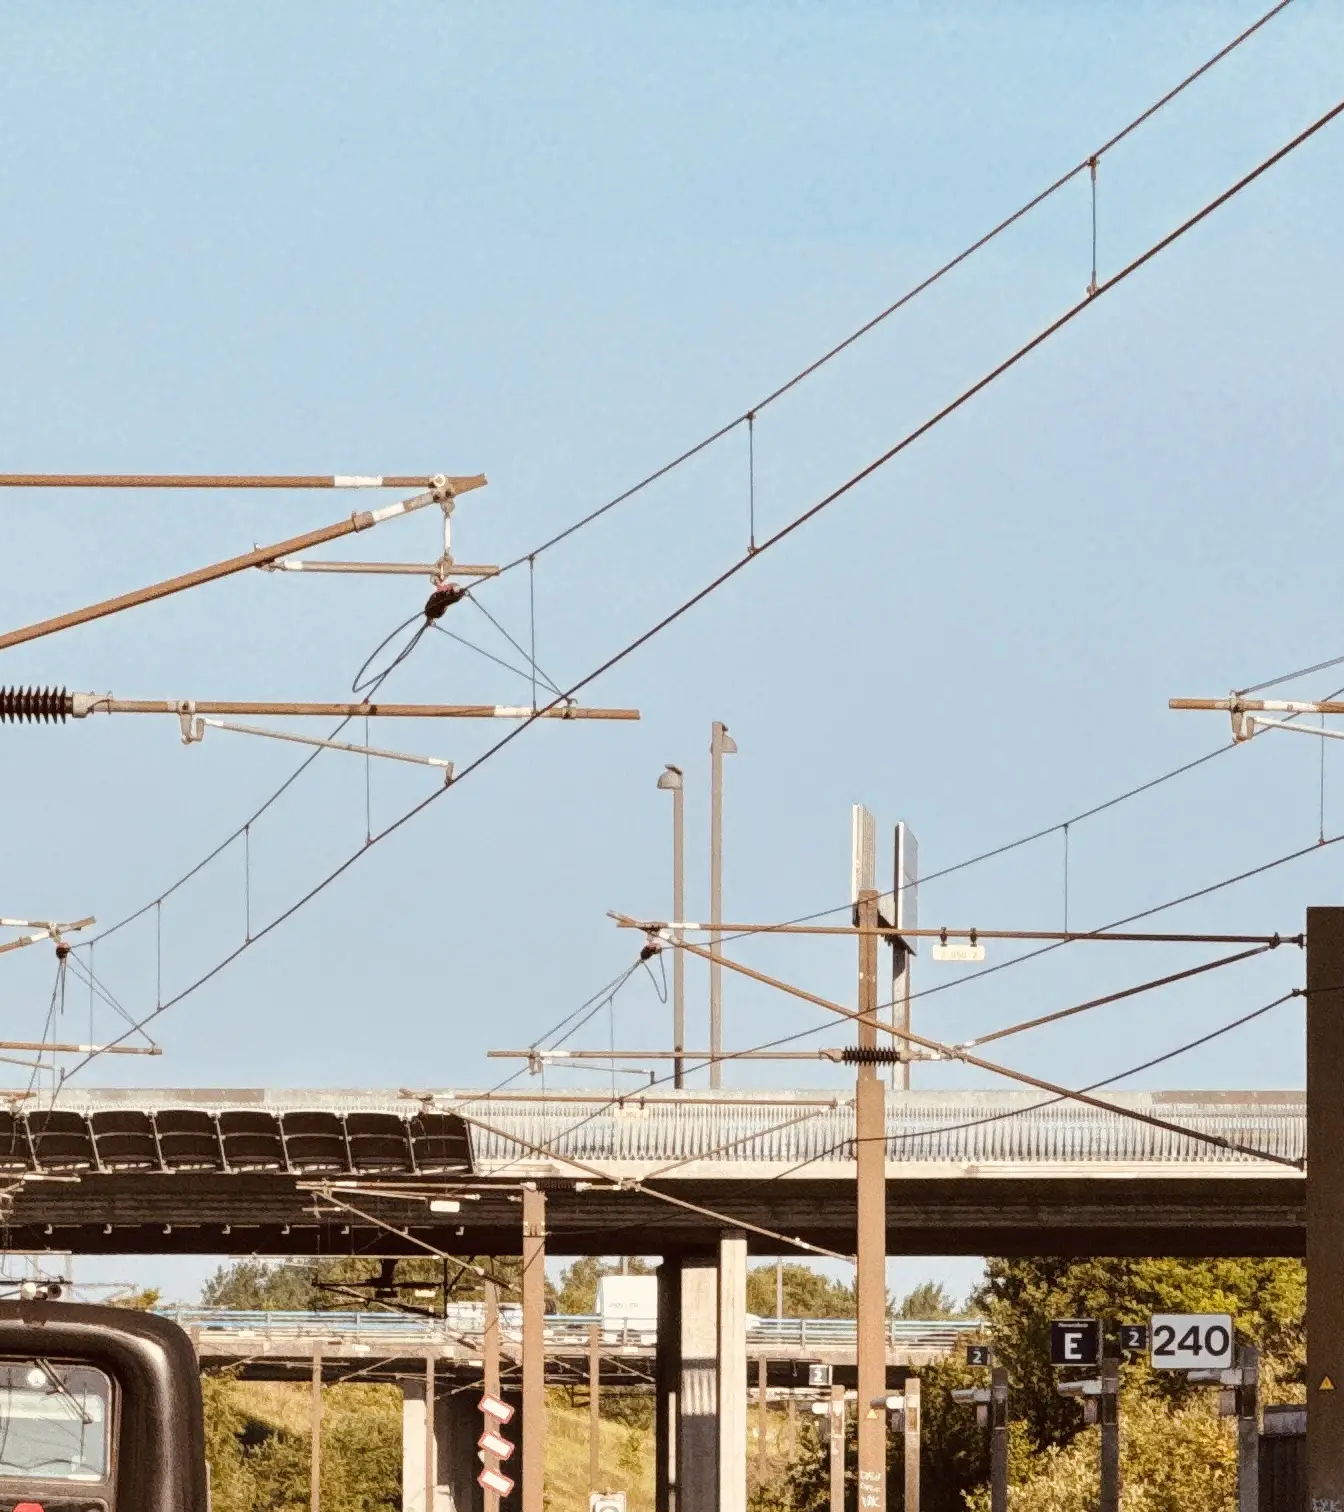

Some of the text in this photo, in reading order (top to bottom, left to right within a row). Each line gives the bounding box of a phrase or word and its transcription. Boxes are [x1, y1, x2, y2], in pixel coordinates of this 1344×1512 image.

[1064, 1332, 1083, 1360] E
[1128, 1331, 1140, 1347] 2
[1154, 1325, 1230, 1357] 240
[972, 1351, 982, 1364] 2
[813, 1371, 823, 1383] 2
